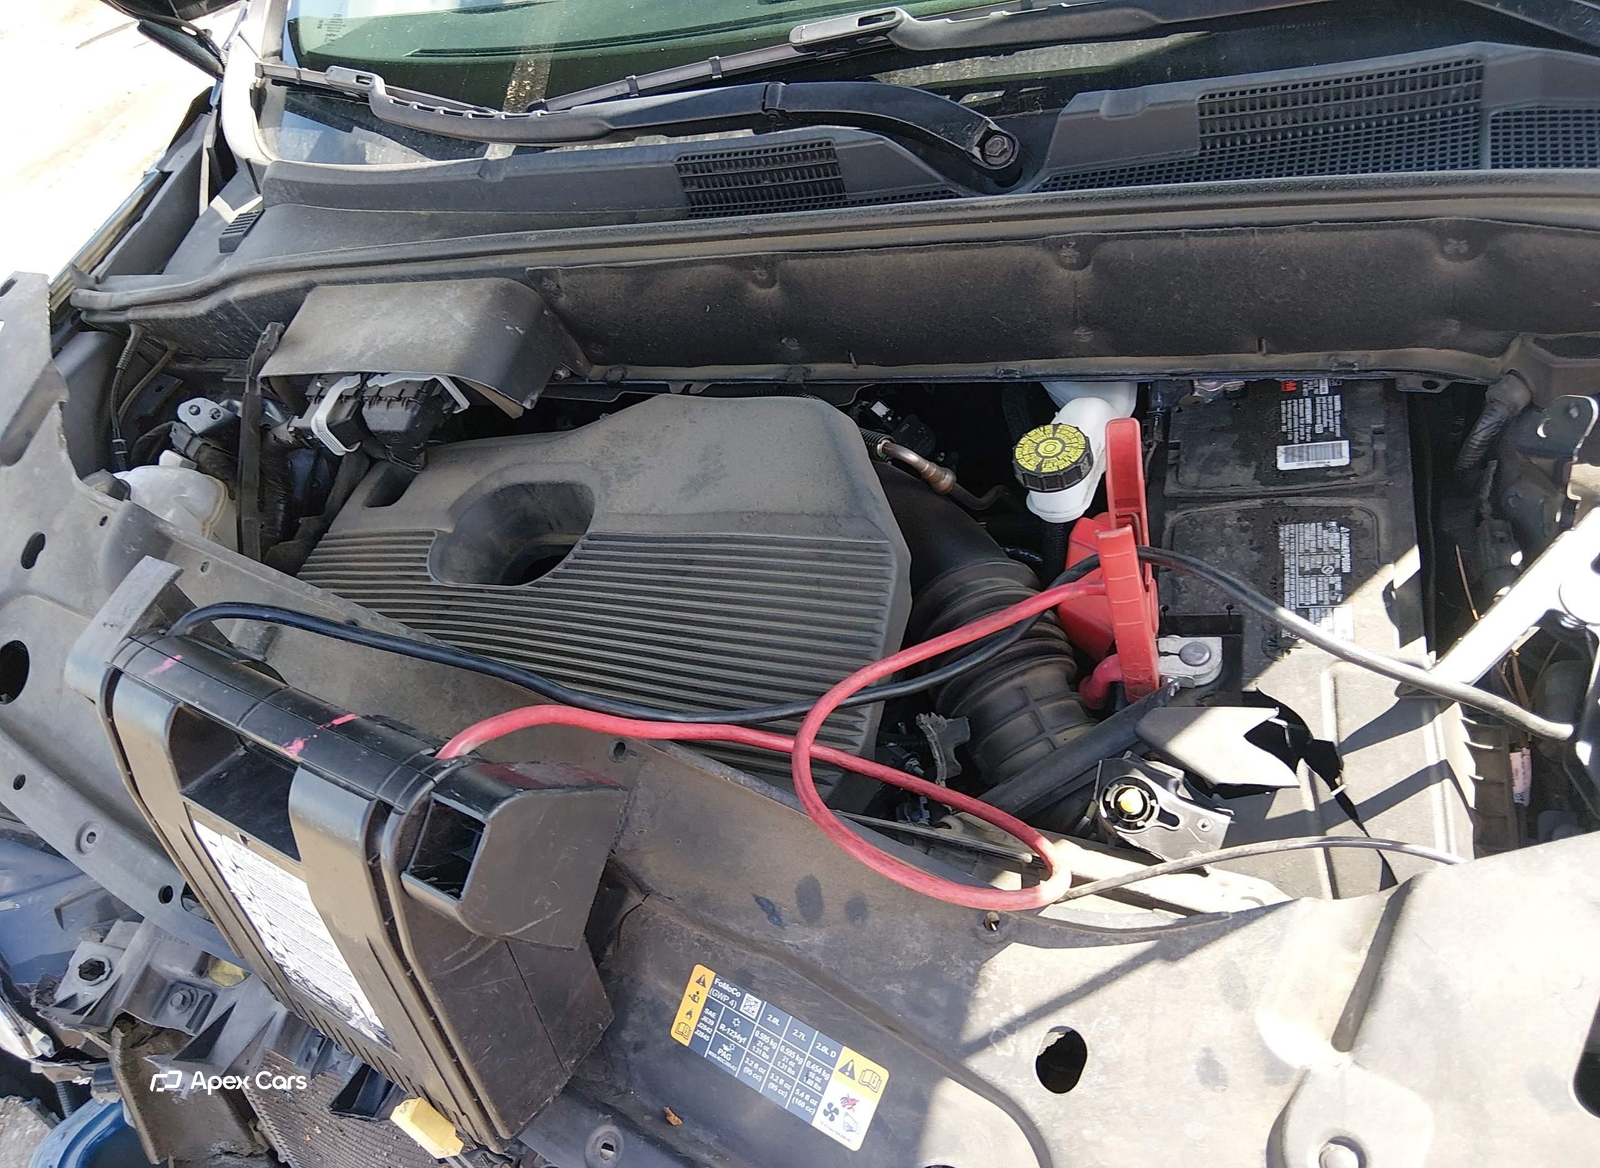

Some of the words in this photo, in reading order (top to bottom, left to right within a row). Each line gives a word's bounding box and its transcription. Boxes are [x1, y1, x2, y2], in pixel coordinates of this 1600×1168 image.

[715, 978, 741, 997] FoMoCo
[704, 1008, 717, 1018] SAE
[718, 1049, 732, 1061] PAG
